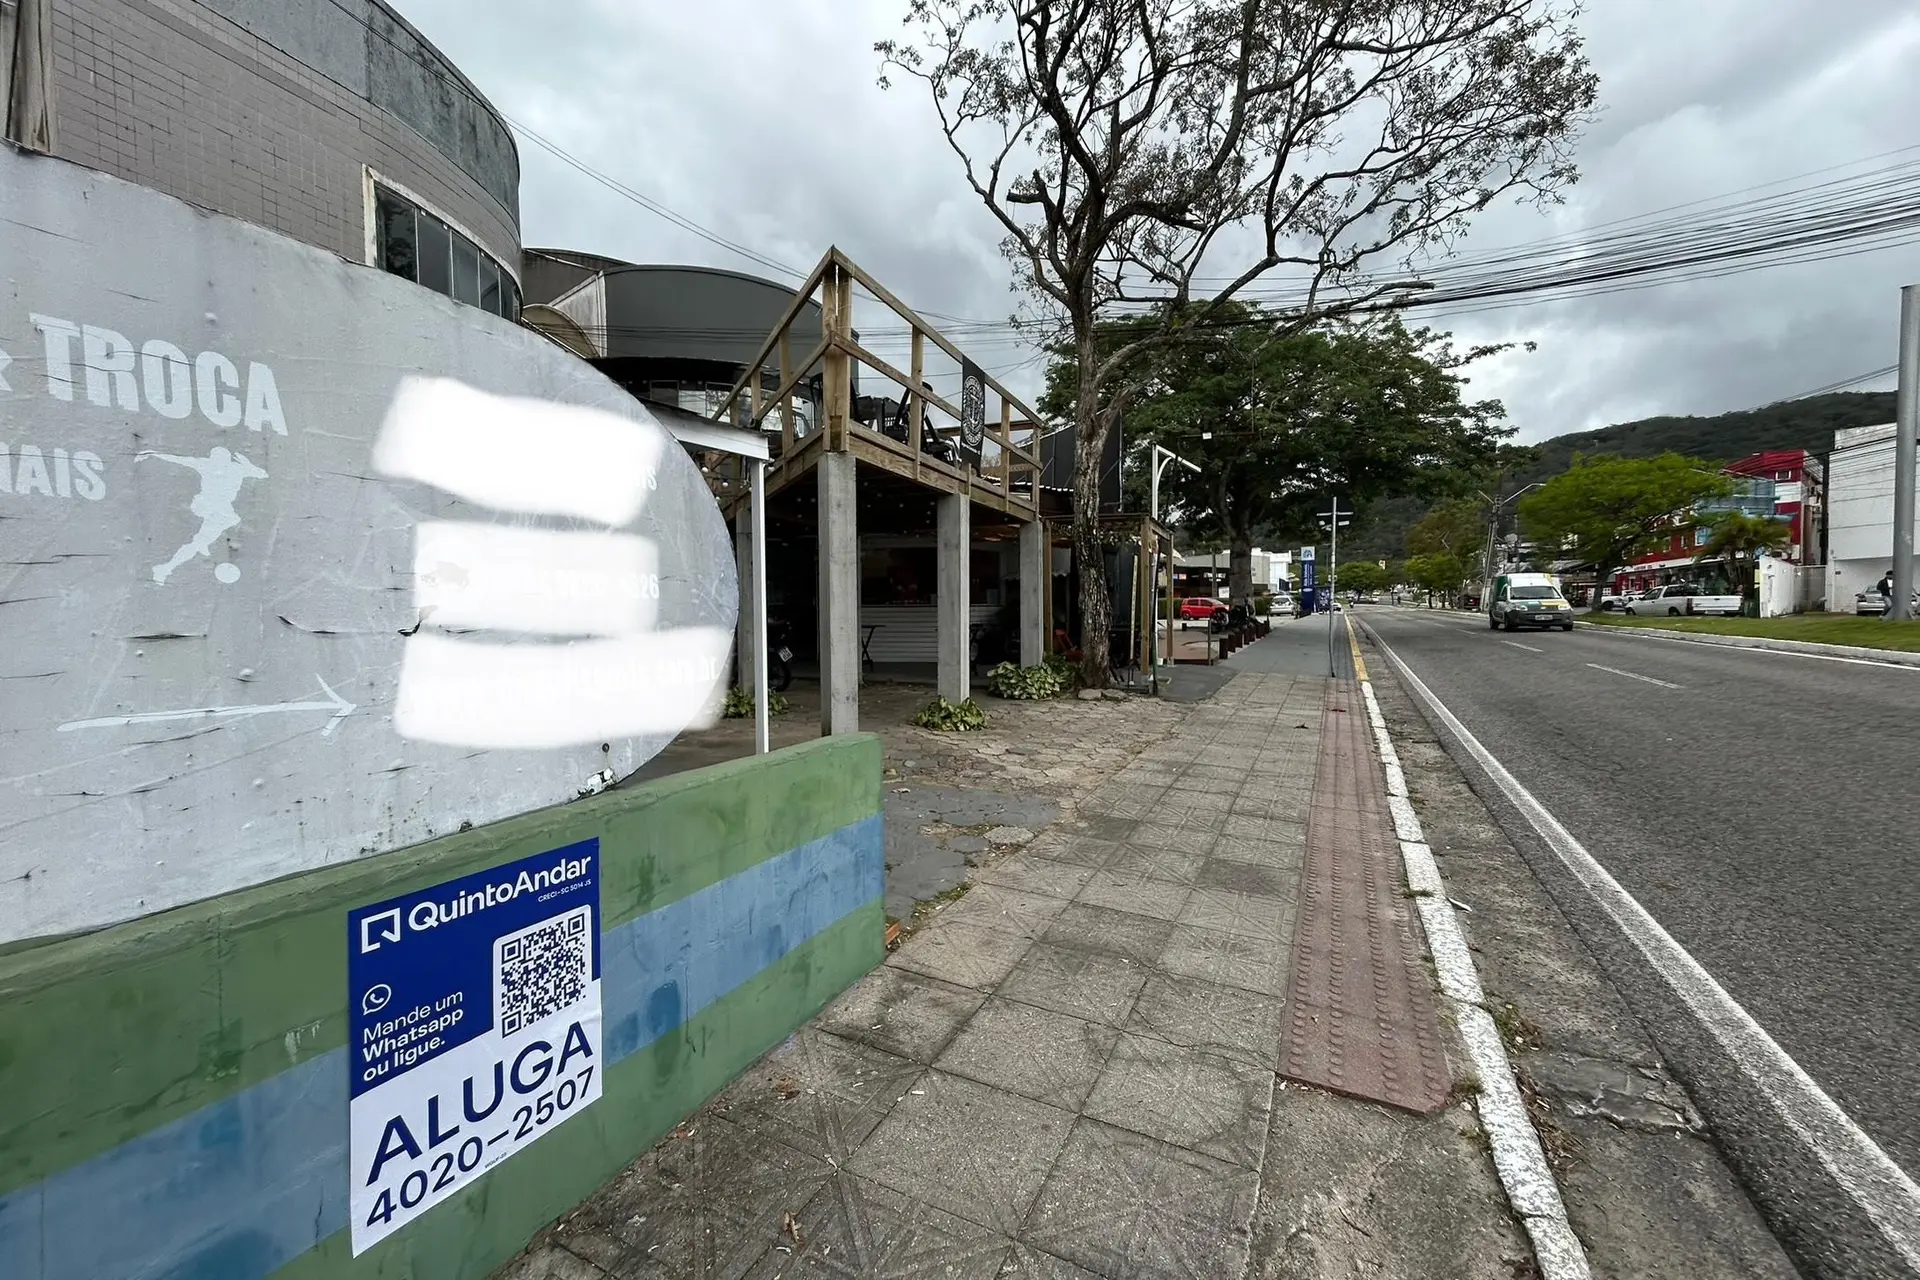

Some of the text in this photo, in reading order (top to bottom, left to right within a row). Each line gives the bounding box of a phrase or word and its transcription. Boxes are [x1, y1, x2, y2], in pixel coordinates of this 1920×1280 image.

[29, 312, 289, 436] TROCA
[409, 856, 592, 929] QuintoAndar
[362, 1009, 464, 1063] Whatsapp
[363, 991, 463, 1044] Mande um
[363, 1037, 446, 1082] ou ligue.
[366, 1021, 594, 1187] ALUGA
[366, 1066, 594, 1228] 4020-2507
